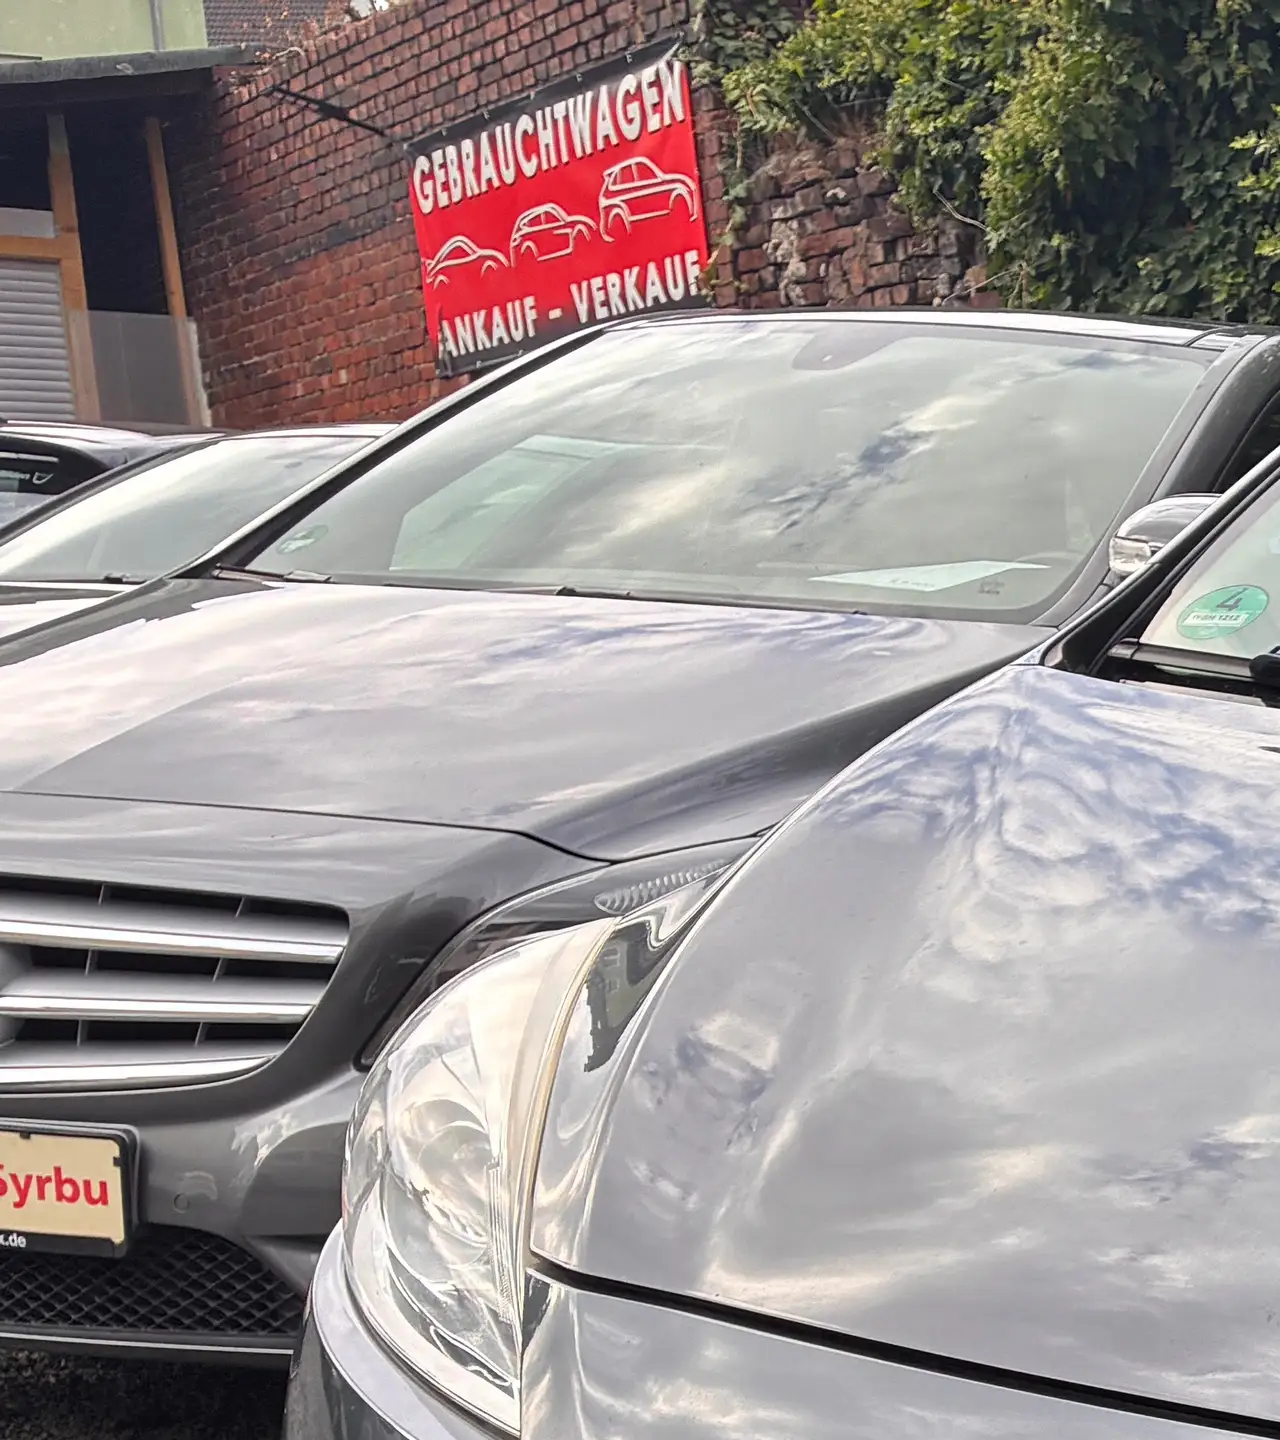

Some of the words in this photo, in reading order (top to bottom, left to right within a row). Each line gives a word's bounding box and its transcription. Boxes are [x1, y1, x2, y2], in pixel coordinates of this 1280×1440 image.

[412, 59, 685, 215] GEBRAUCHTWAGEN
[438, 295, 537, 360] ANKAUF
[569, 249, 702, 325] VERKAUF
[1216, 587, 1248, 612] 4
